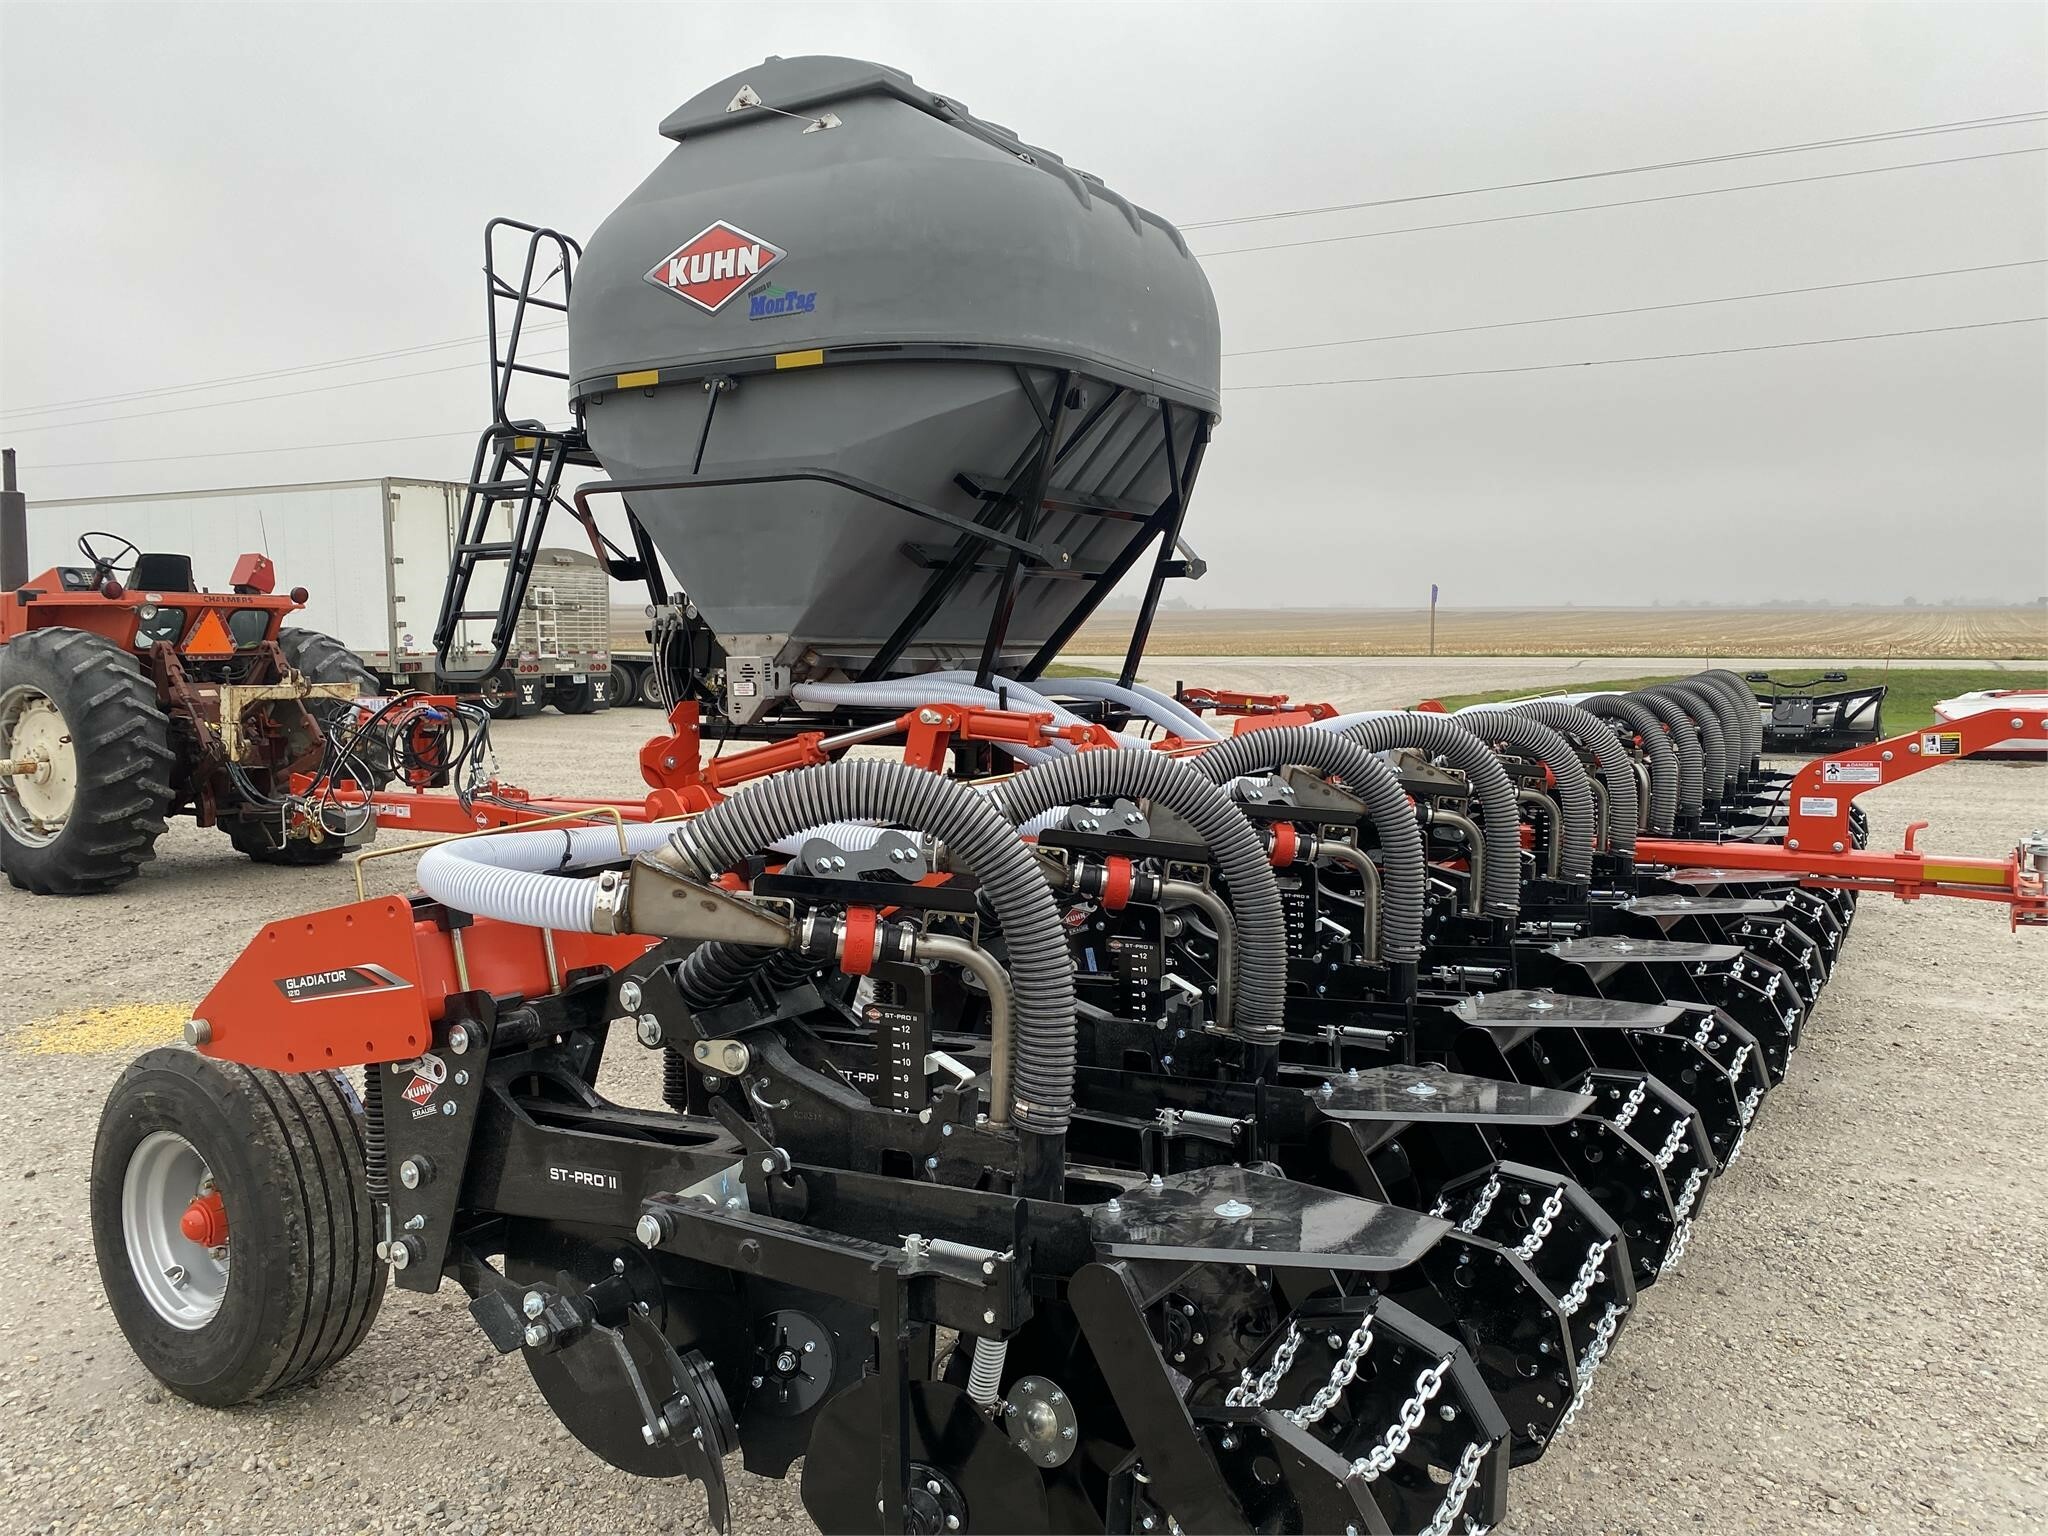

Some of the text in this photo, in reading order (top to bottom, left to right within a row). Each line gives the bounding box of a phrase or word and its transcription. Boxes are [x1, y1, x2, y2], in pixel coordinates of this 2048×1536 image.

[668, 244, 760, 287] KUHN
[749, 290, 817, 317] MonTag
[203, 595, 254, 604] CHALMERS
[1066, 912, 1086, 923] KUHN
[286, 970, 346, 989] GLADIATOR
[287, 989, 300, 997] 1210
[884, 1012, 911, 1021] ST-PRO
[901, 1025, 911, 1034] 12
[901, 1042, 910, 1050] 11
[901, 1058, 911, 1067] 10
[903, 1074, 909, 1083] 9
[407, 1083, 433, 1099] KUHN
[903, 1091, 909, 1099] 8
[412, 1105, 437, 1118] KRAUSE
[550, 1167, 617, 1189] ST-PRO II
